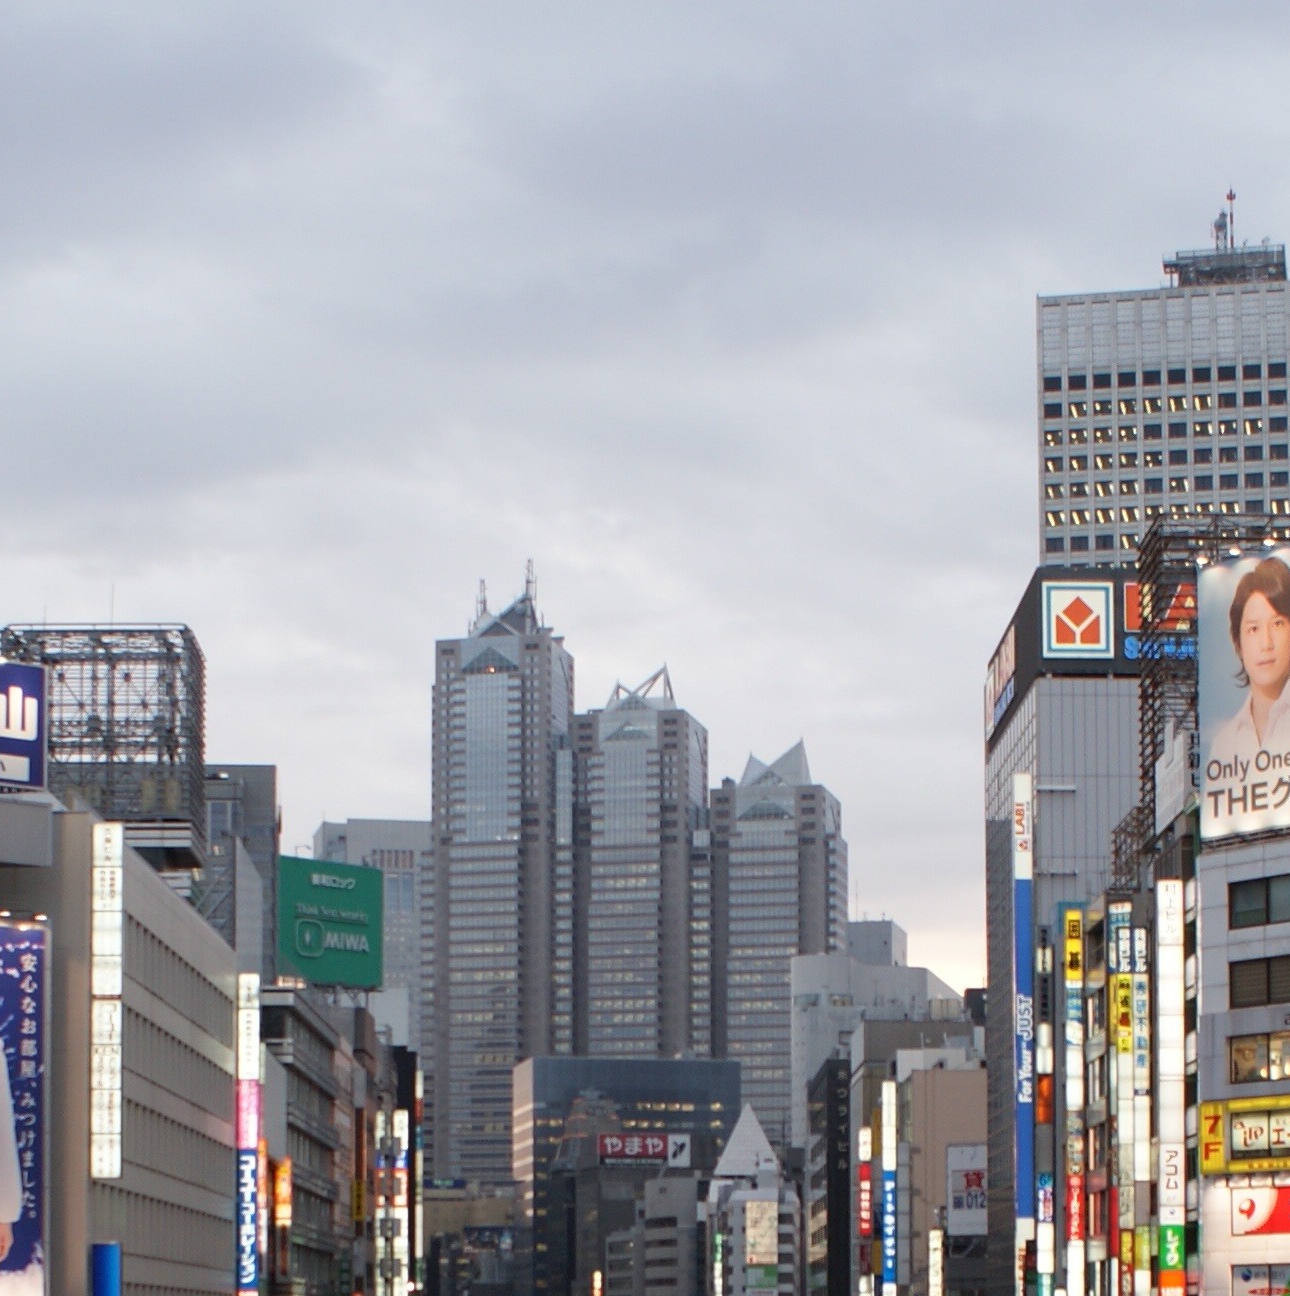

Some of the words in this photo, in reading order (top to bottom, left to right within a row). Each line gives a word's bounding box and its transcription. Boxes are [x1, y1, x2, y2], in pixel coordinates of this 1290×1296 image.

[1207, 756, 1250, 786] Only
[324, 931, 370, 952] MIWA
[603, 1136, 664, 1156] やまや
[1165, 1150, 1180, 1191] アコム
